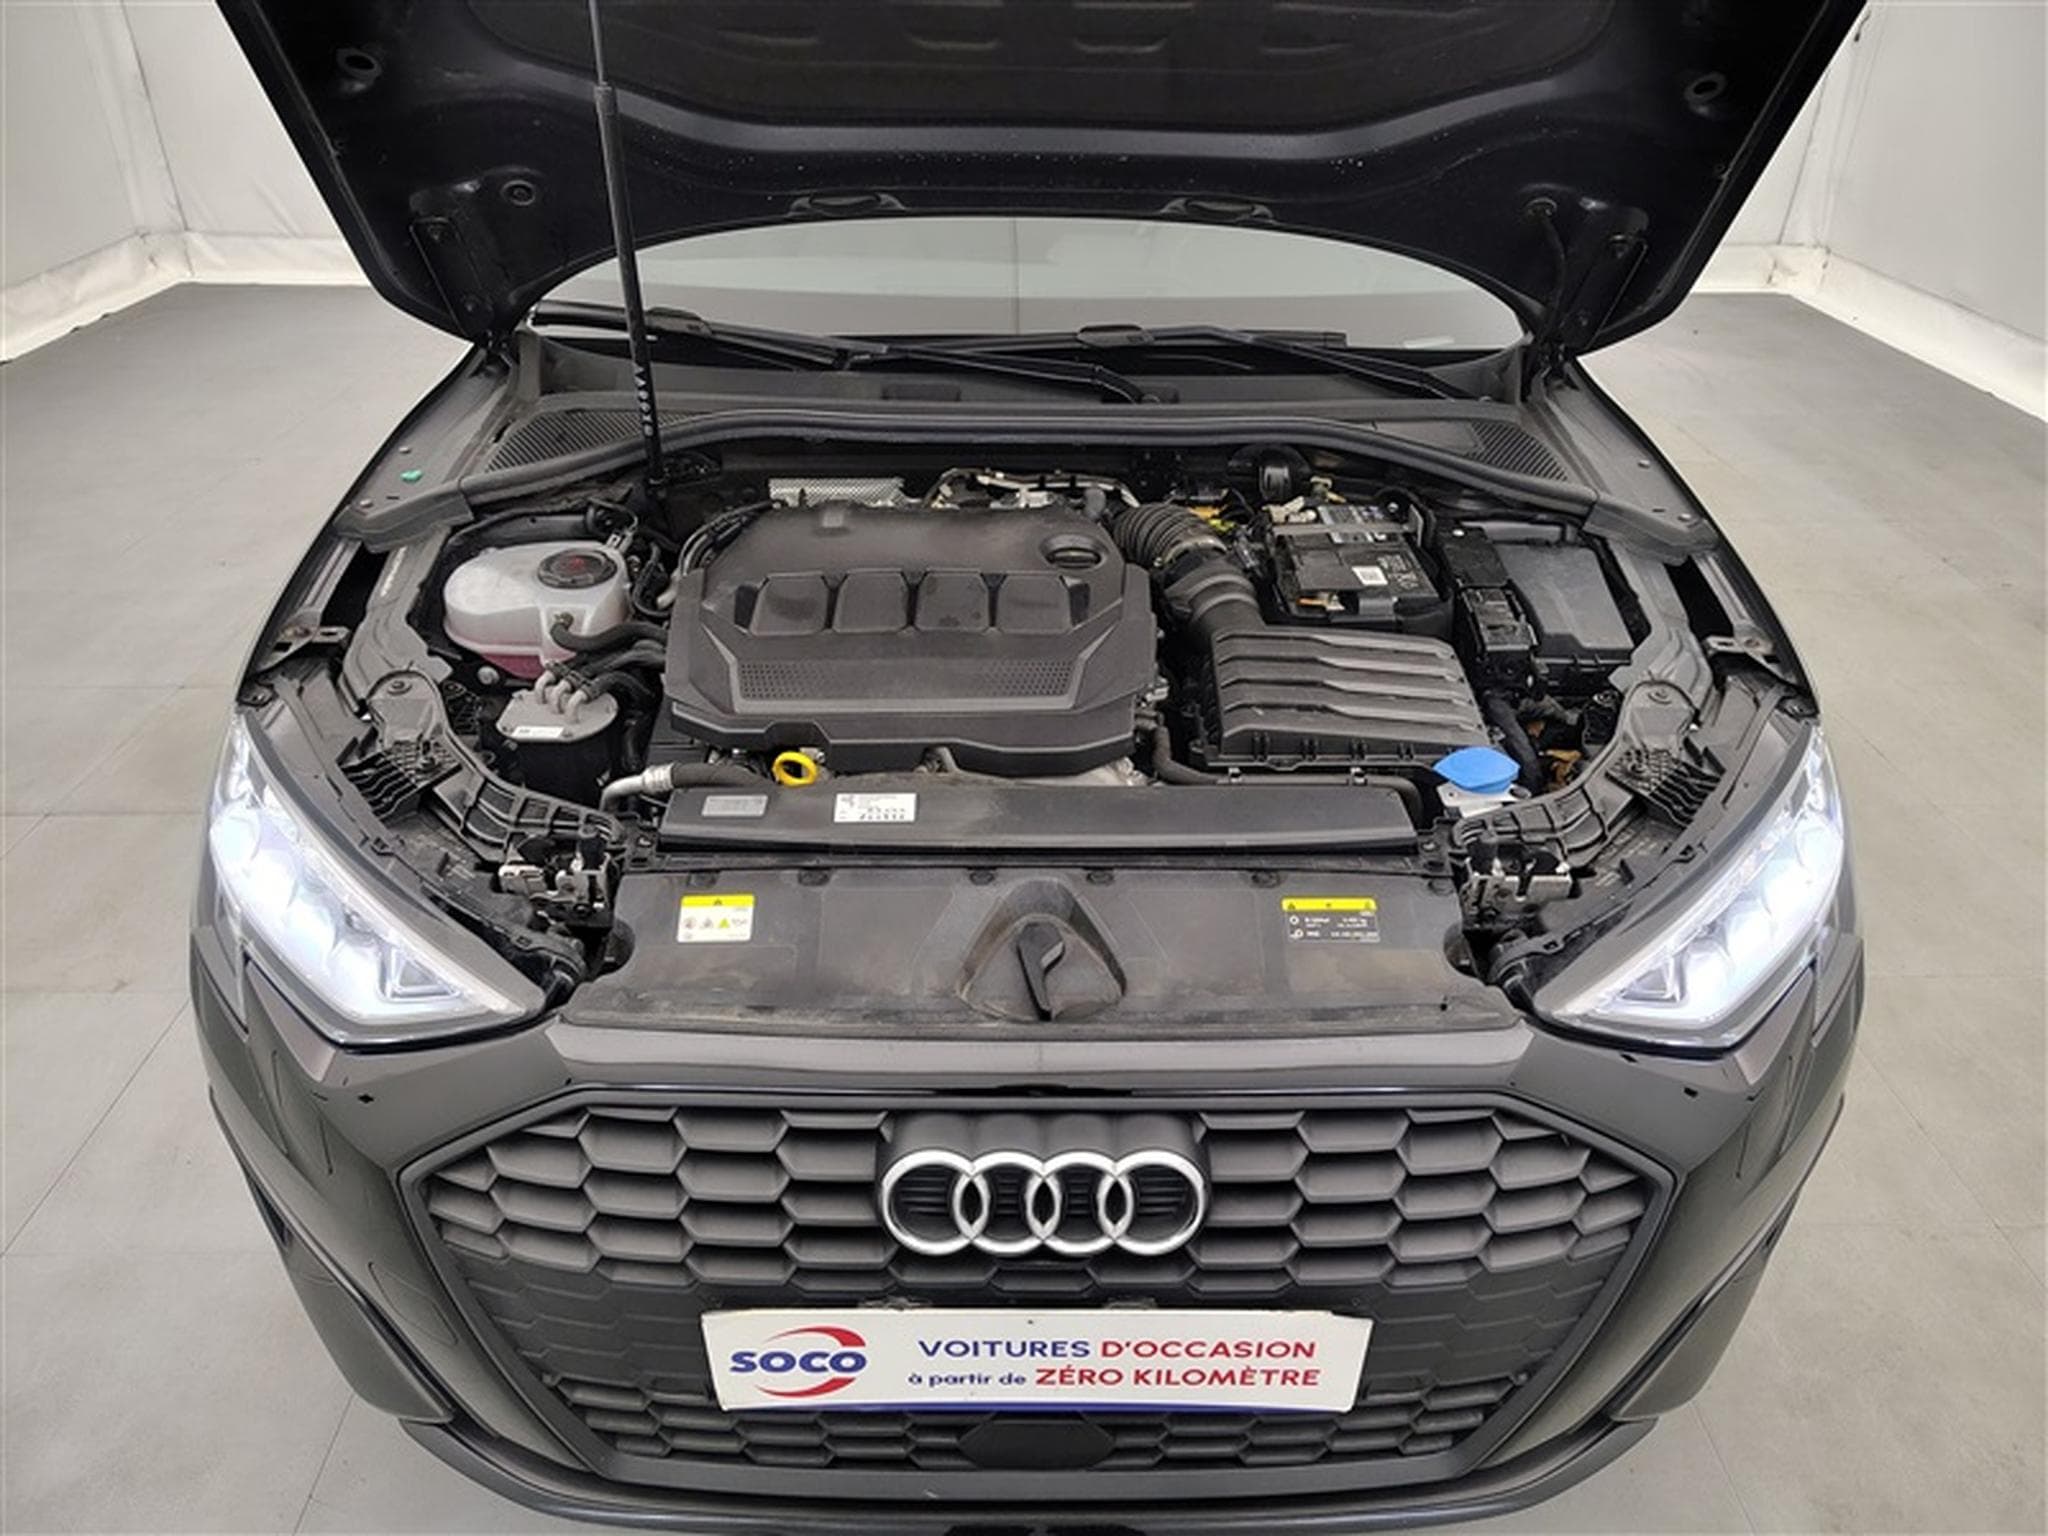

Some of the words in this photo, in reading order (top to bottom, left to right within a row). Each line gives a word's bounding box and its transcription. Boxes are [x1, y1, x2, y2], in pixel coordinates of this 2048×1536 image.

[918, 1340, 1091, 1358] VOITURES
[1101, 1340, 1316, 1358] D'OCCASION
[729, 1351, 867, 1373] SOCO
[908, 1372, 923, 1386] à
[928, 1372, 991, 1387] partir
[999, 1372, 1026, 1386] de
[1035, 1364, 1124, 1386] ZÉRO
[1133, 1365, 1321, 1386] KILOMÈTRE
